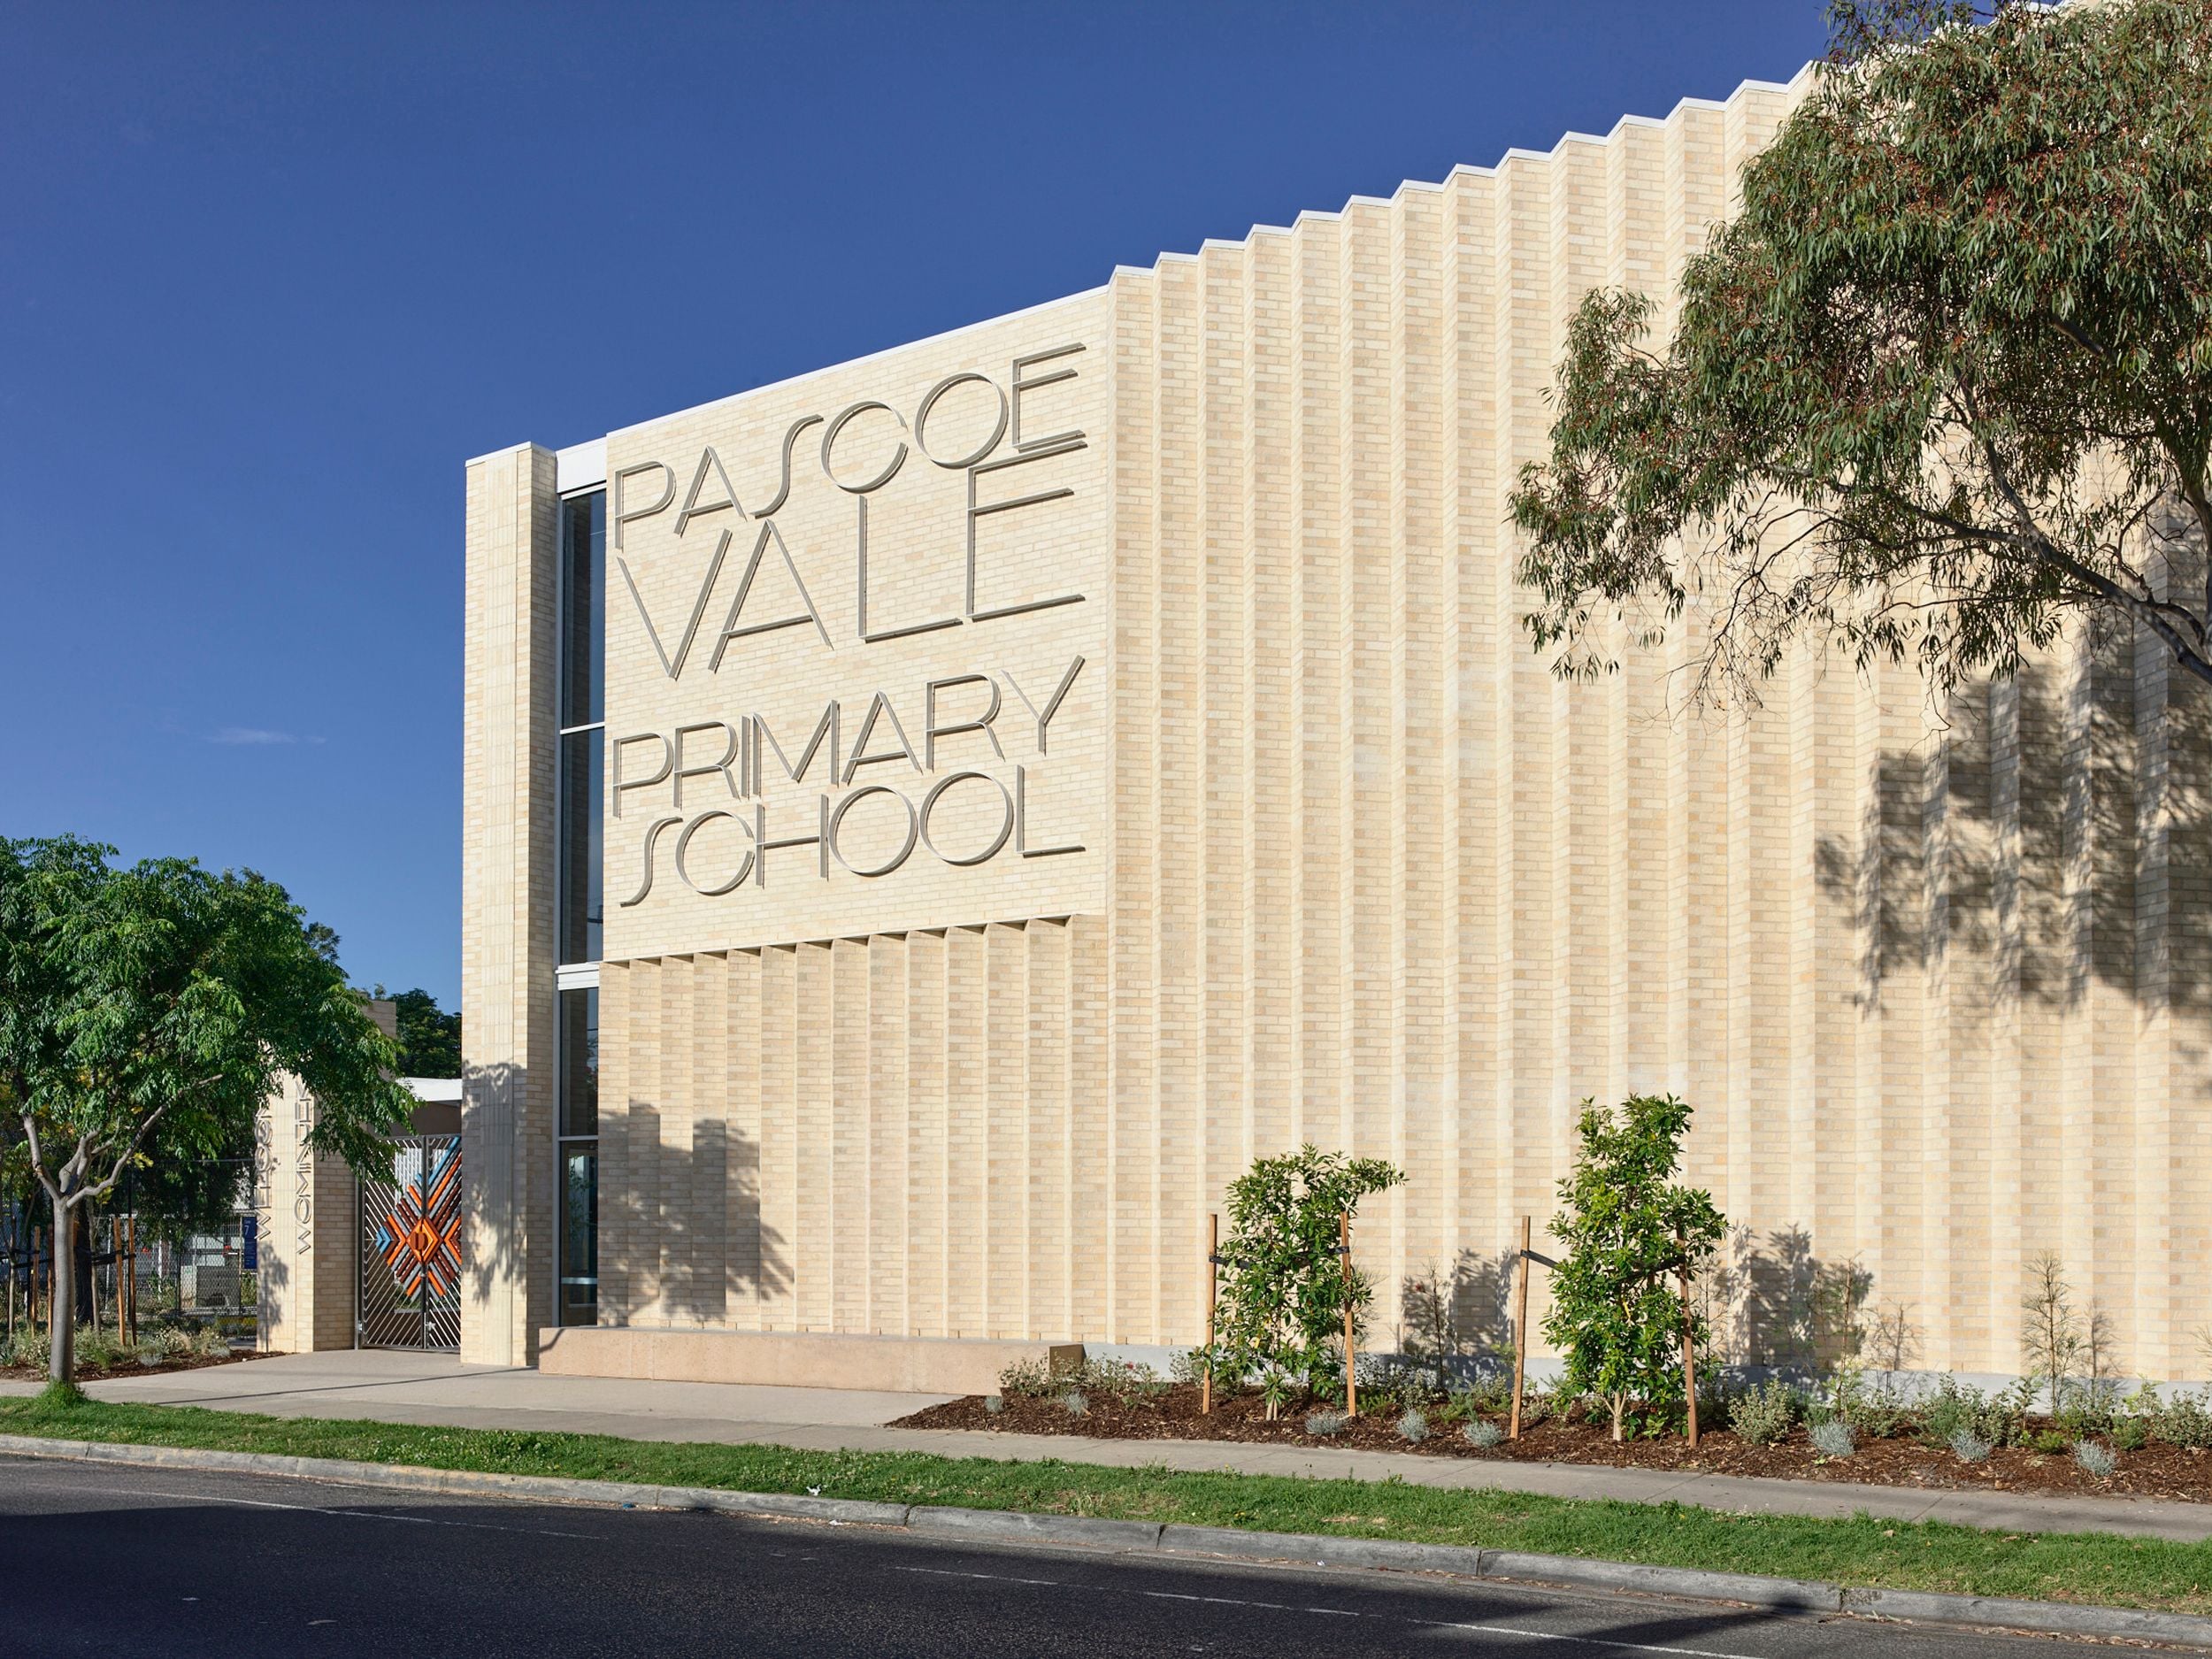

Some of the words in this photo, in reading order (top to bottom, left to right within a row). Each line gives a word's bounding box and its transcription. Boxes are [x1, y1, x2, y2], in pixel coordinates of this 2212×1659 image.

[613, 342, 1087, 552] PASCOE
[617, 441, 1088, 681] VALE
[612, 655, 1086, 820] PRIMARY
[620, 764, 1086, 908] SCHOOL
[253, 1097, 273, 1240] WELCO
[295, 1078, 311, 1255] WOMINJEK
